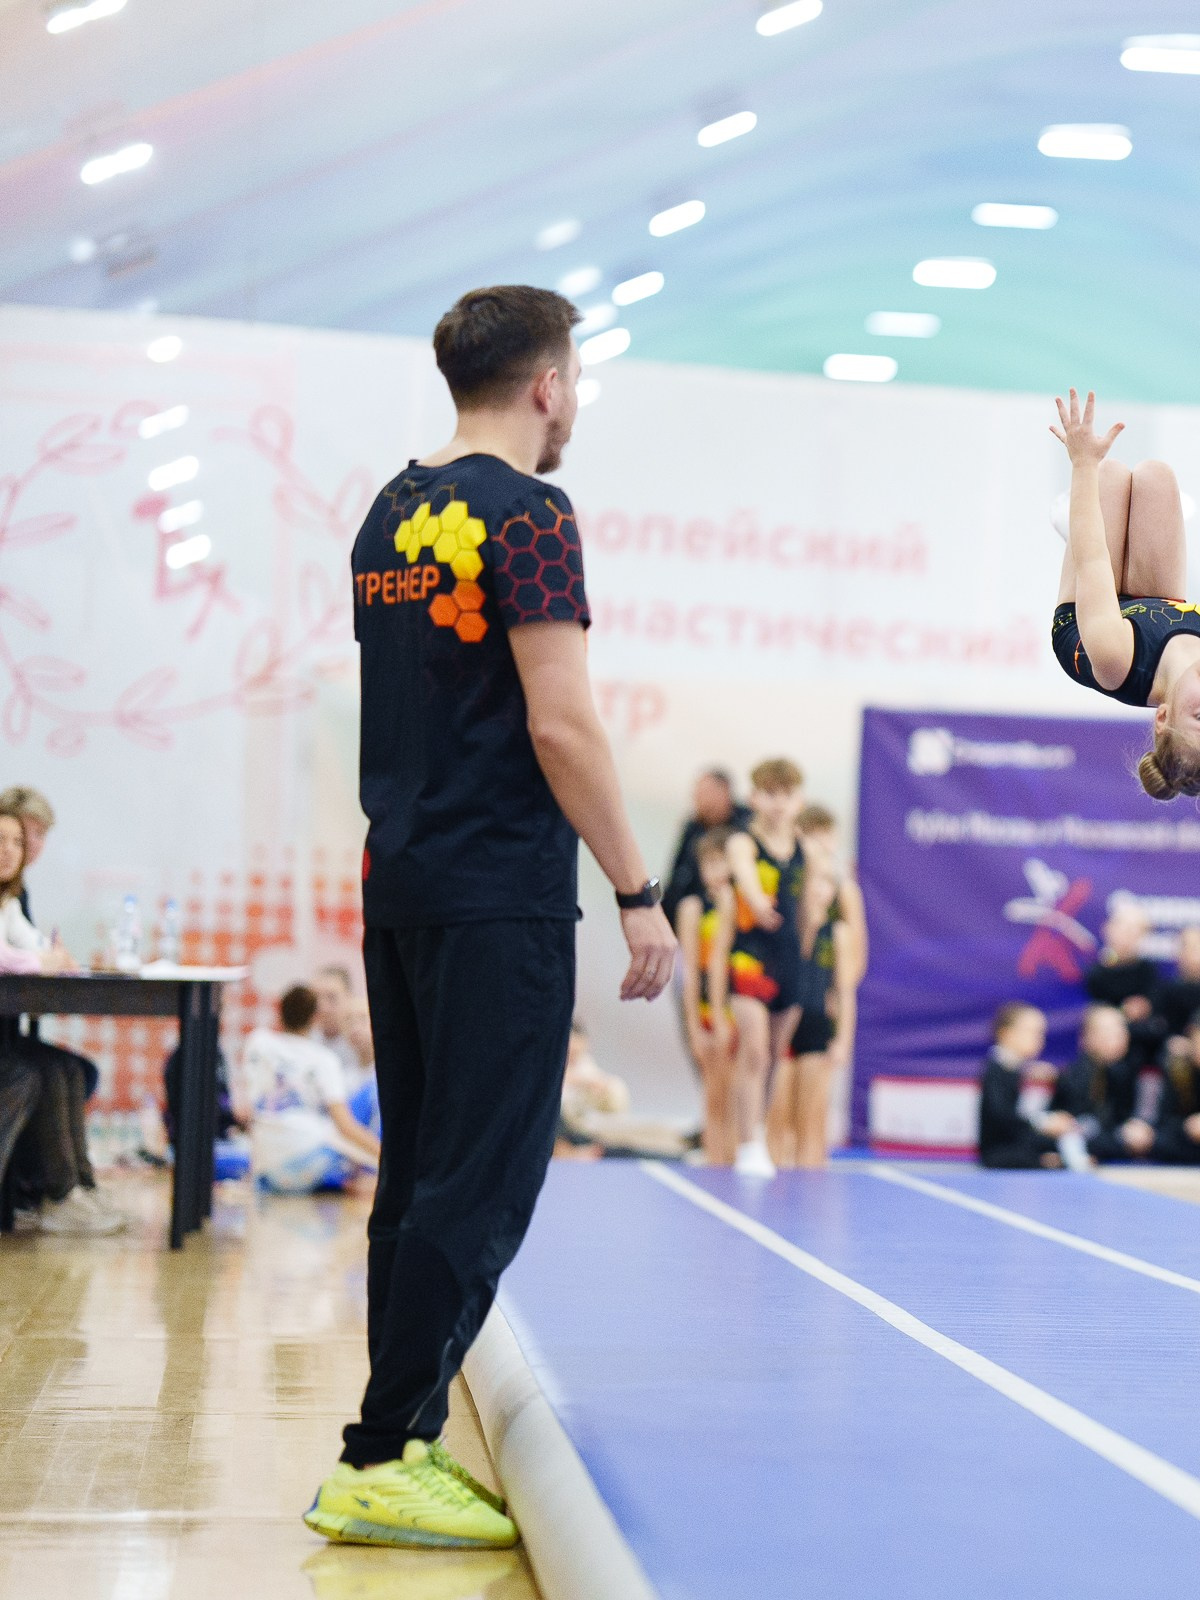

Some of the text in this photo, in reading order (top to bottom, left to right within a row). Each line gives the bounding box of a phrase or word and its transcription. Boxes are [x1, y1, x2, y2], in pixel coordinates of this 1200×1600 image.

[578, 508, 929, 576] опейский
[355, 564, 441, 607] ТРЕНЕР
[590, 597, 1042, 668] настический
